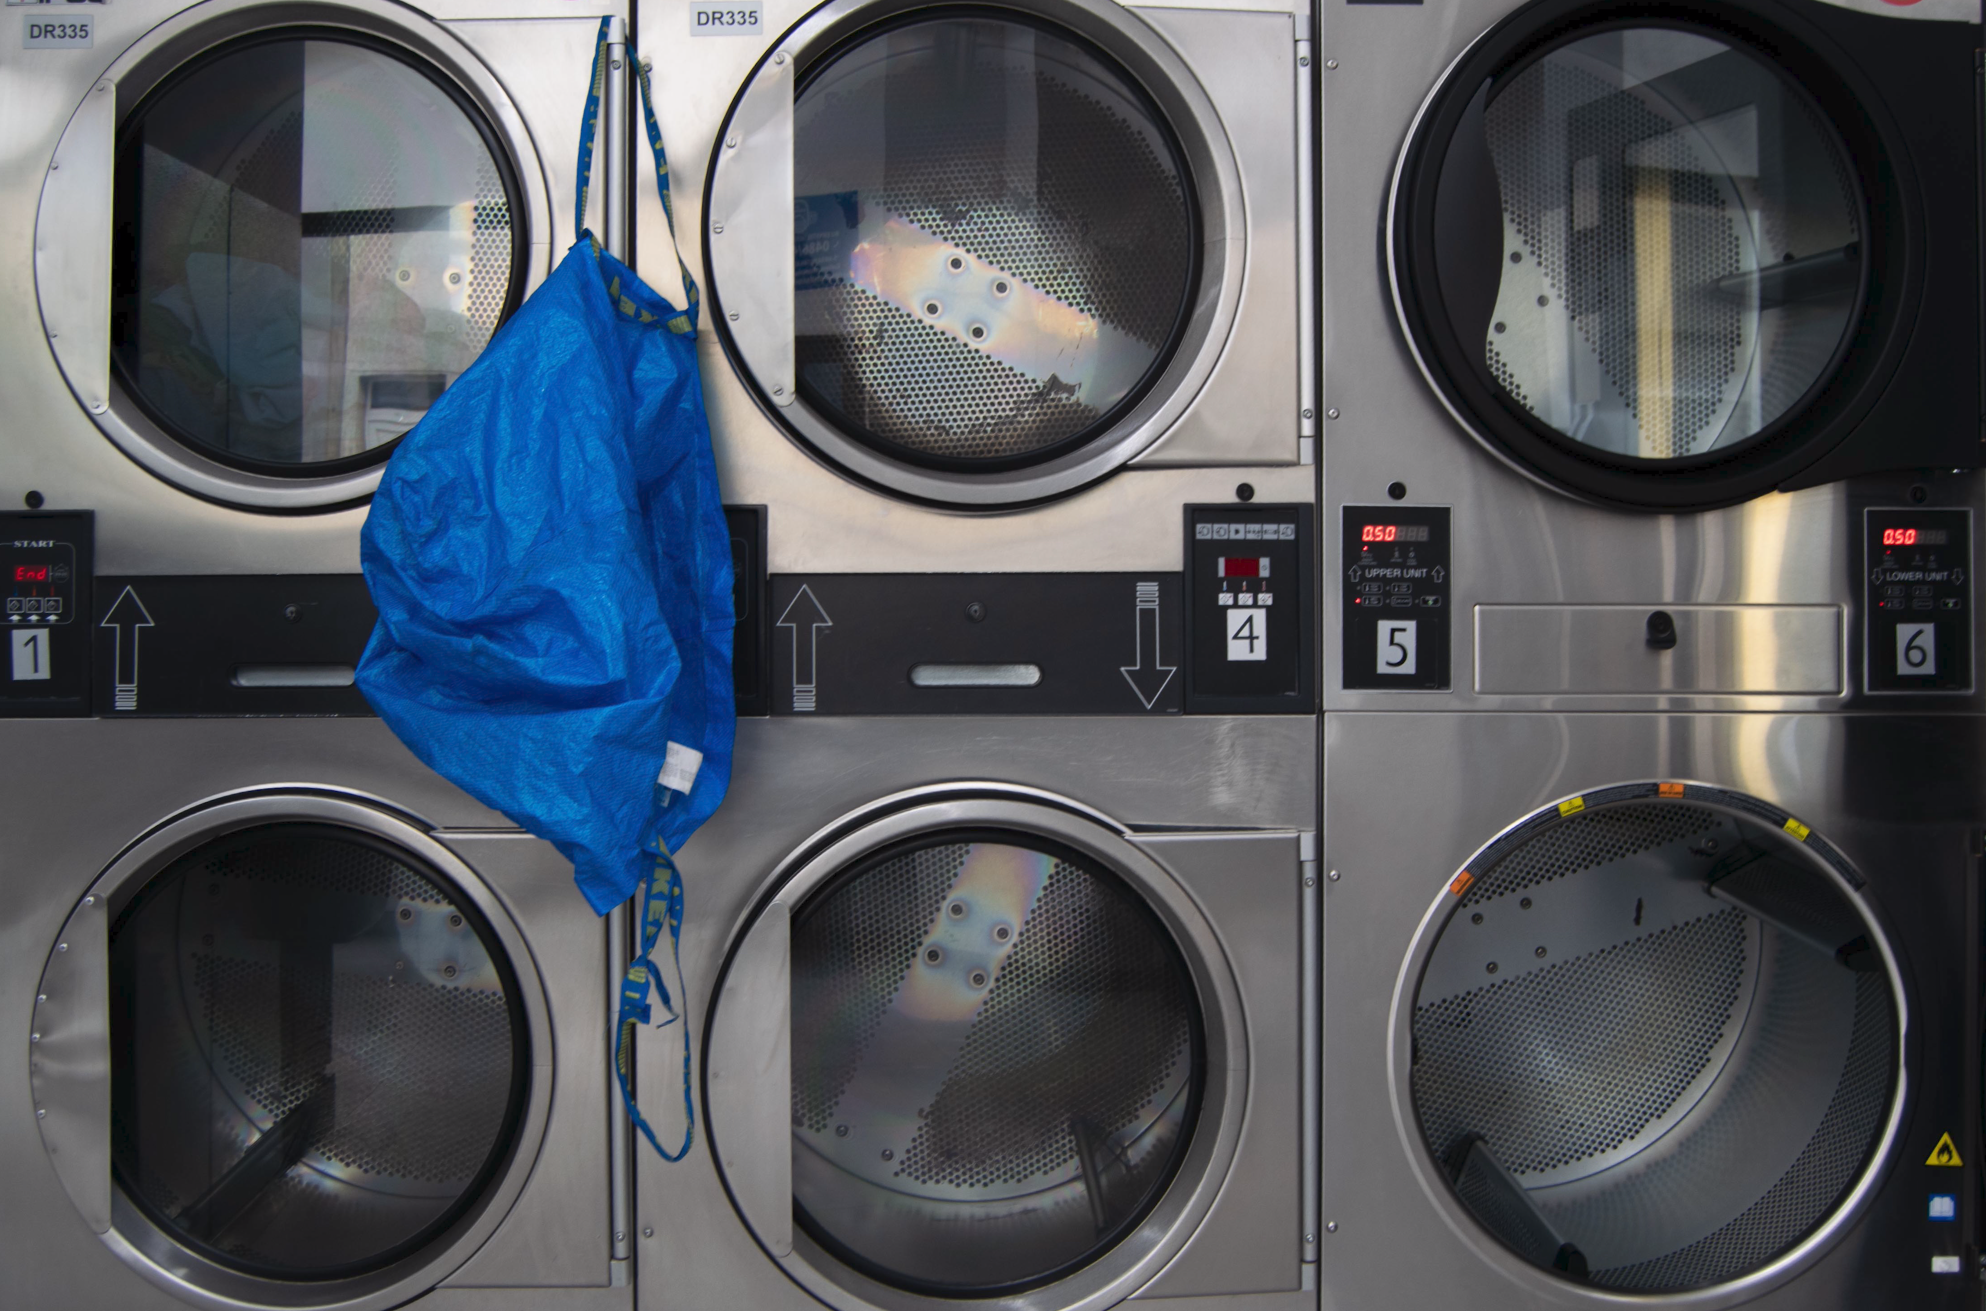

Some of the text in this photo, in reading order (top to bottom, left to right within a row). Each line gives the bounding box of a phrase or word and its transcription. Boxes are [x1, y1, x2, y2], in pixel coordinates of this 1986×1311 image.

[697, 10, 758, 26] DR335
[30, 24, 89, 39] DR335
[13, 540, 55, 548] START
[15, 566, 47, 581] End
[1365, 568, 1428, 578] UPPER UNIT
[1886, 571, 1949, 581] LOWER UNIT
[1231, 614, 1260, 653] 4
[23, 634, 39, 674] 1
[1385, 628, 1408, 667] 5
[1904, 628, 1927, 668] 6
